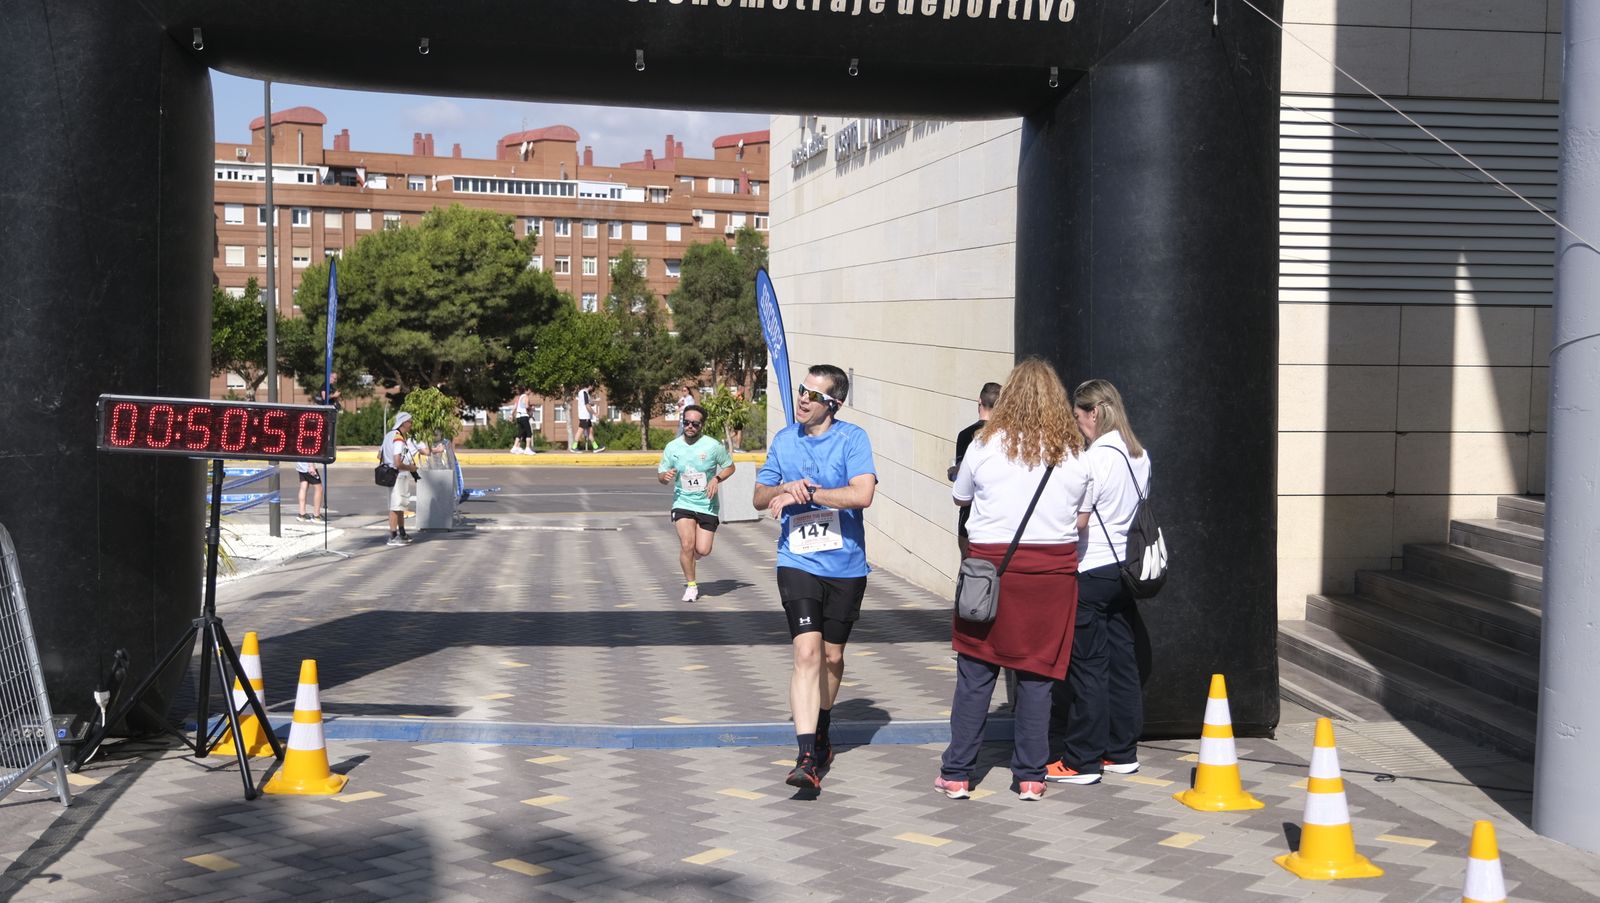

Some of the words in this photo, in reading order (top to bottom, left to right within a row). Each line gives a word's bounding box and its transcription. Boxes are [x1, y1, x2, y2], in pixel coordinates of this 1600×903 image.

[110, 402, 324, 455] 00:50:58
[687, 478, 699, 486] 14
[798, 522, 830, 539] 147
